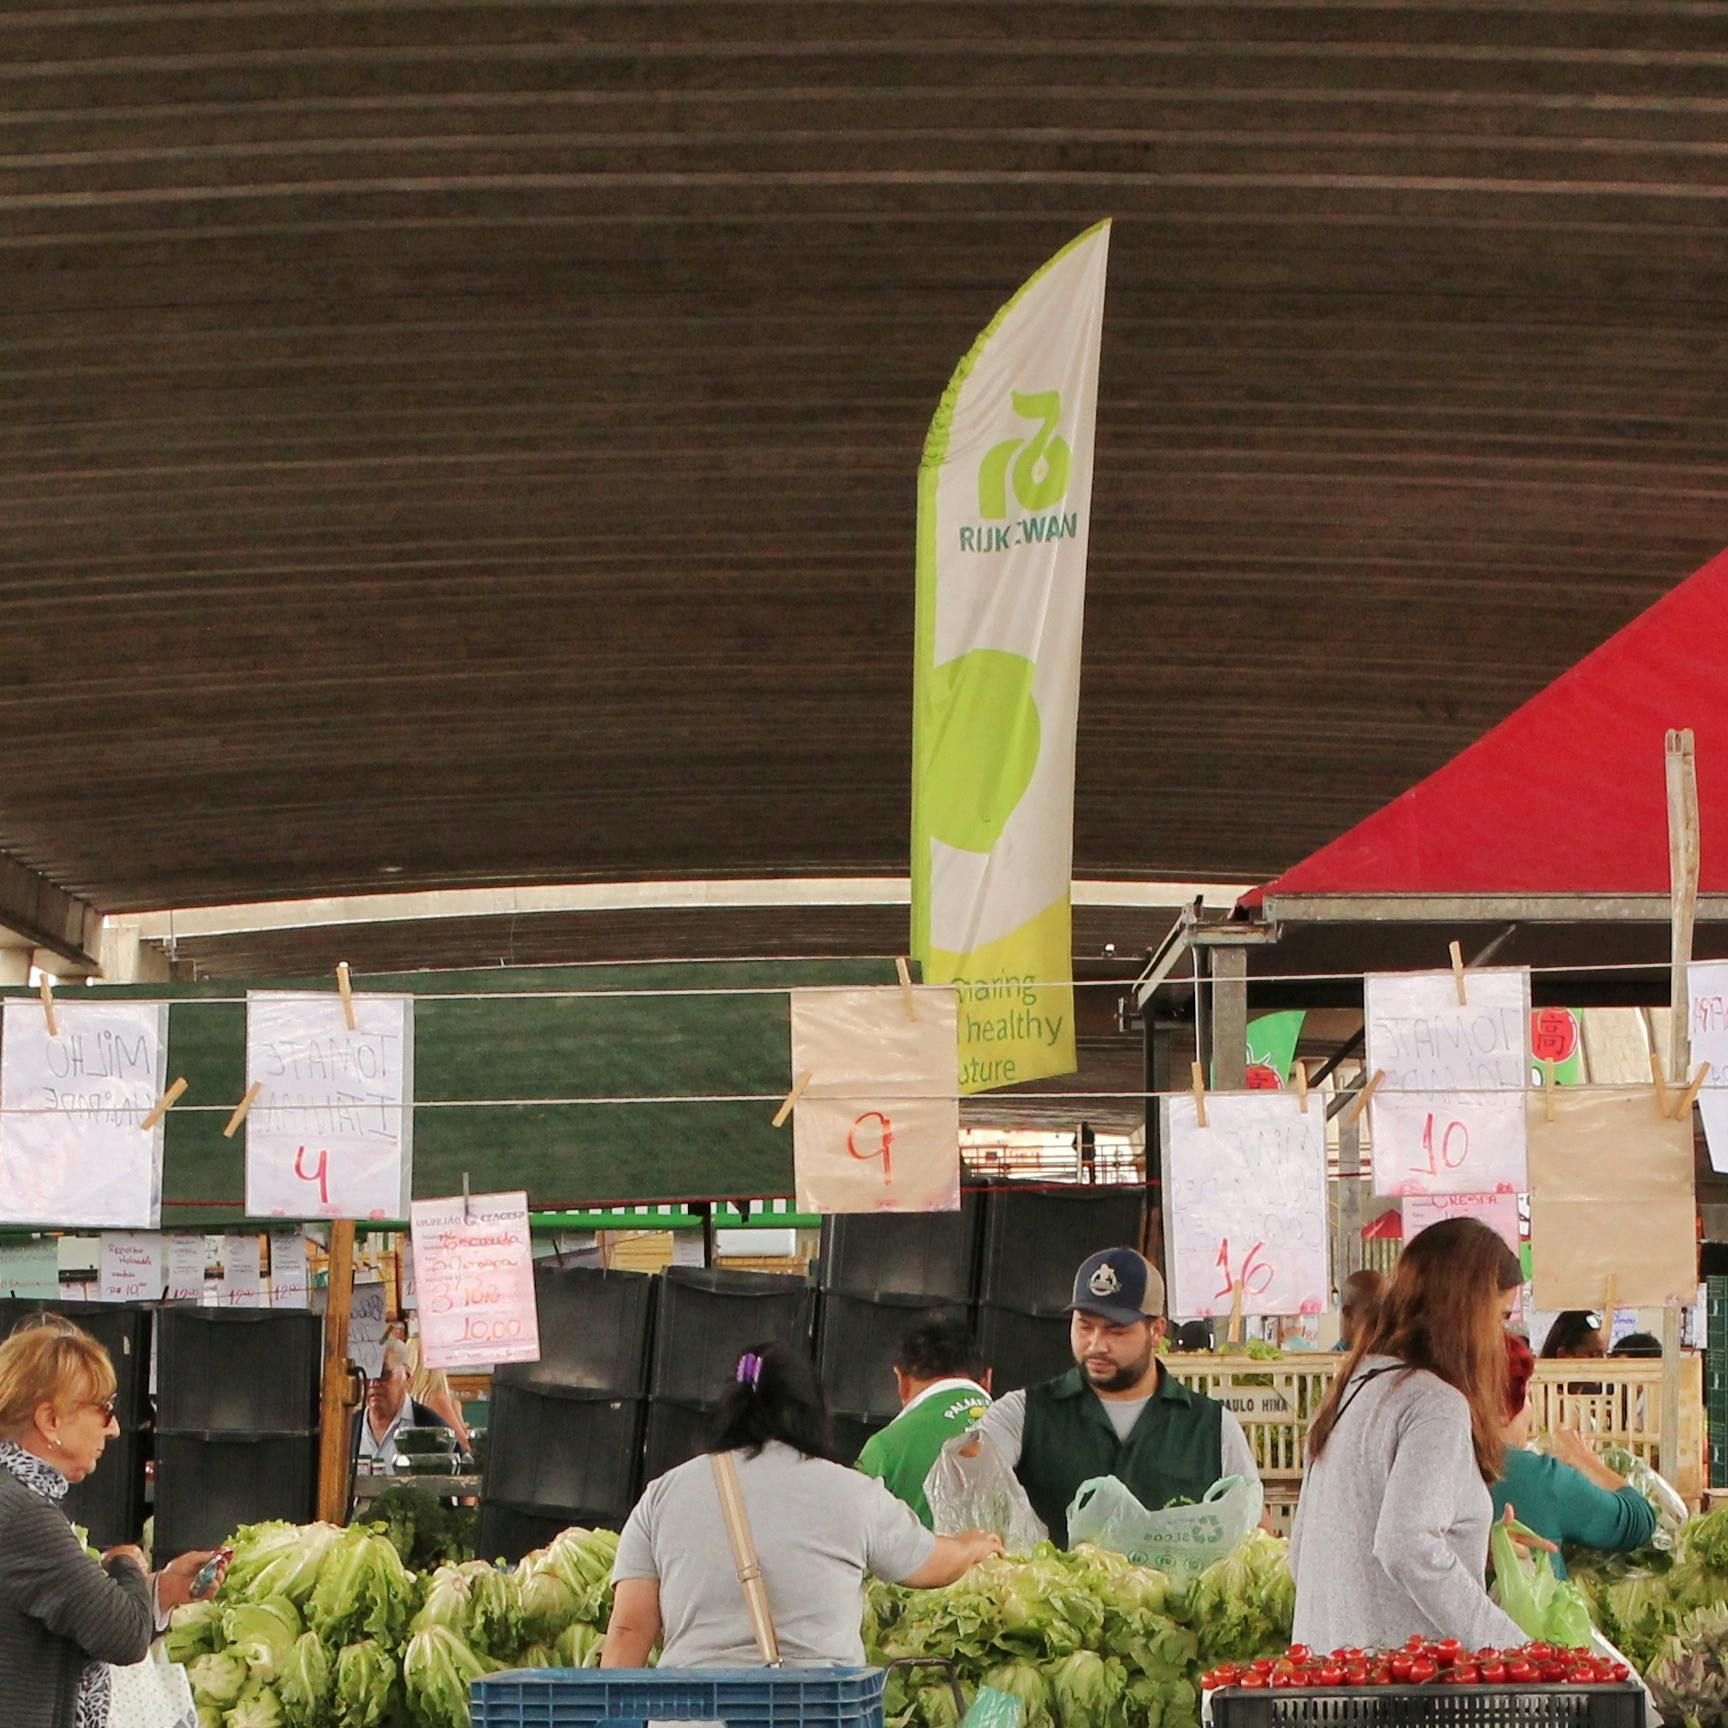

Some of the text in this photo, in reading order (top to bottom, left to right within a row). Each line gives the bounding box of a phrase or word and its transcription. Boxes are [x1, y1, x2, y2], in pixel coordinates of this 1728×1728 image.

[966, 1008, 1063, 1047] healthy
[958, 1056, 1016, 1085] uture
[293, 1143, 329, 1204] 4
[845, 1109, 896, 1187] 9
[1409, 1111, 1471, 1177] 10
